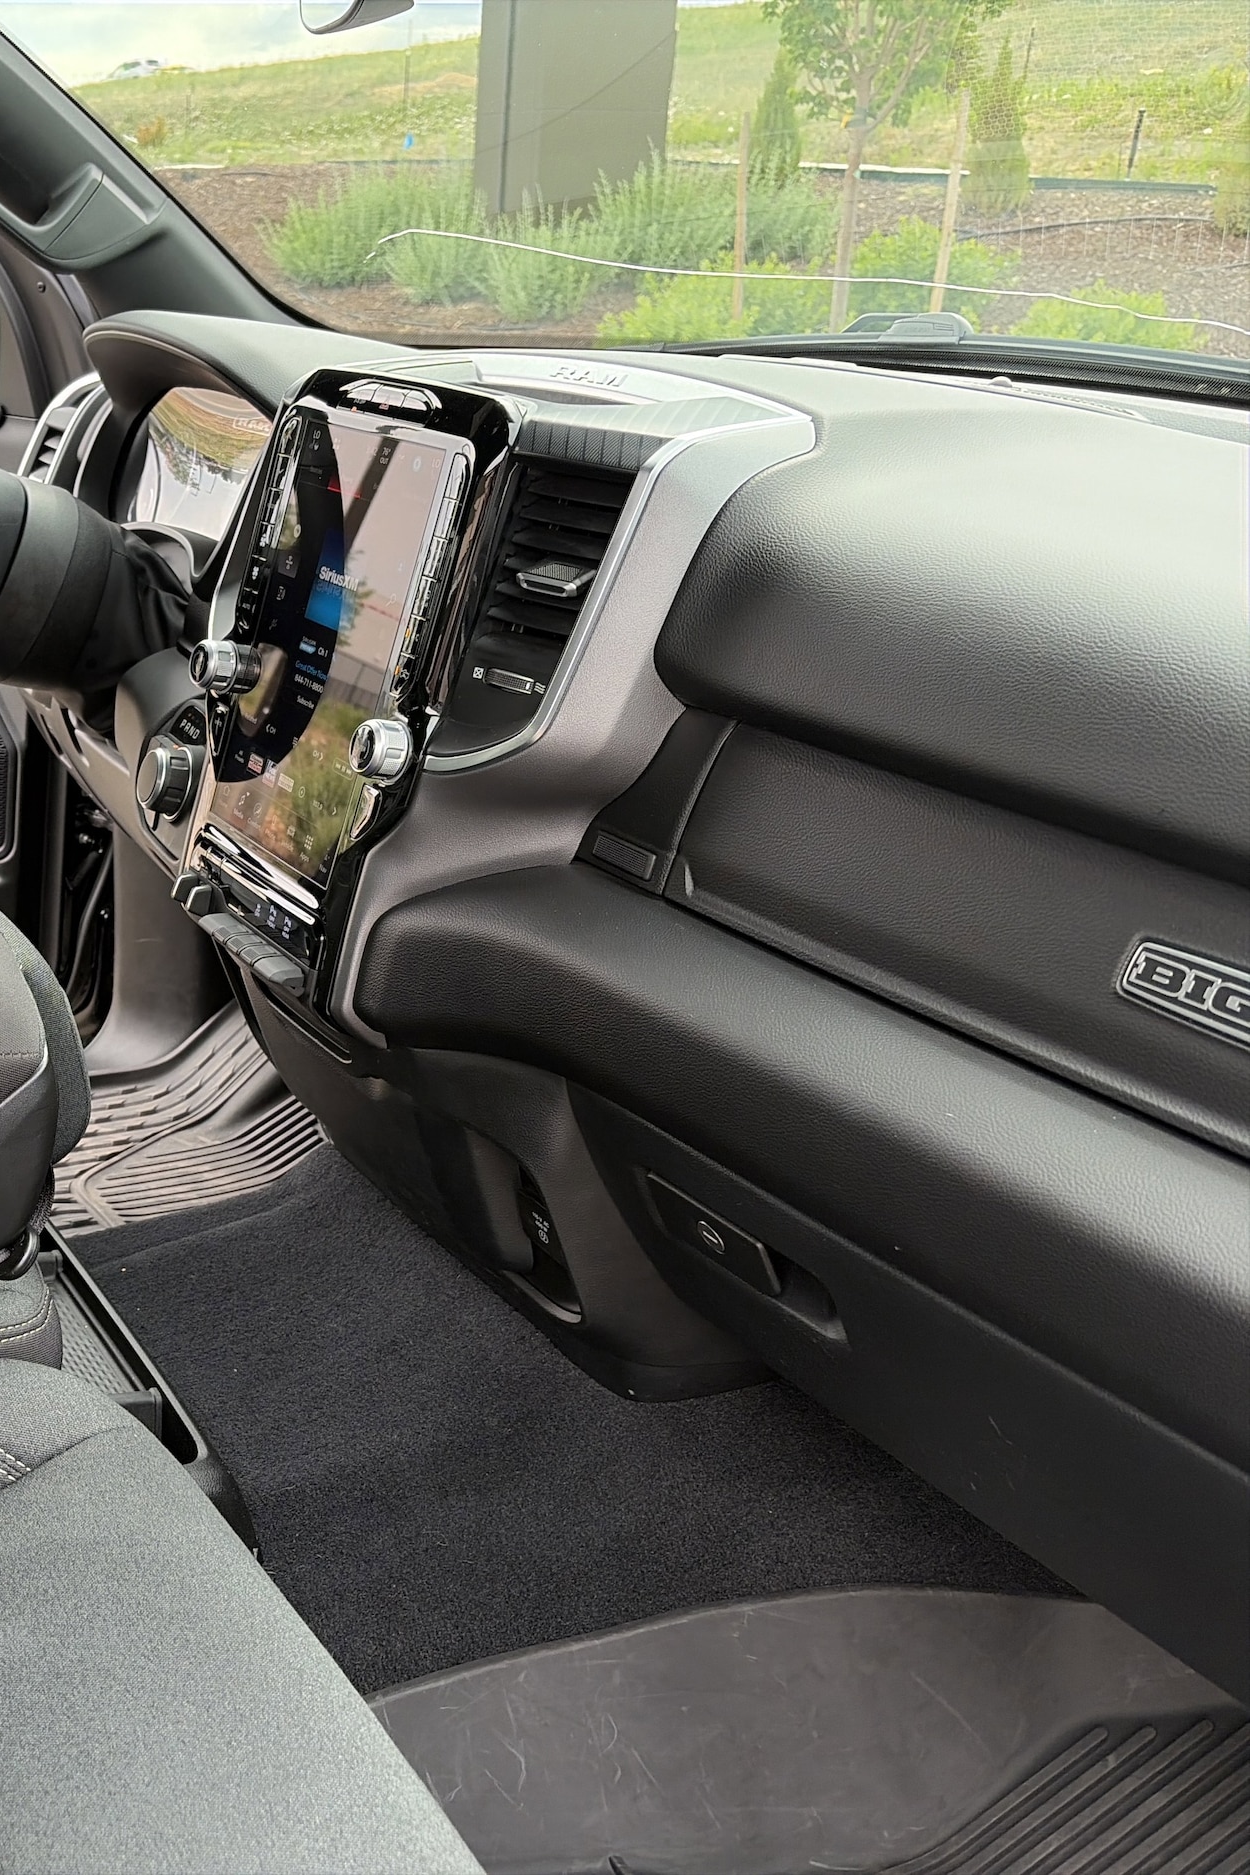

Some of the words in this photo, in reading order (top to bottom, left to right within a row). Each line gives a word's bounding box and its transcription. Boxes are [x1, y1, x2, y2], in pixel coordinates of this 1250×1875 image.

[549, 365, 630, 389] RAM
[318, 565, 360, 593] SiriusXM
[1128, 950, 1250, 1027] BIG
